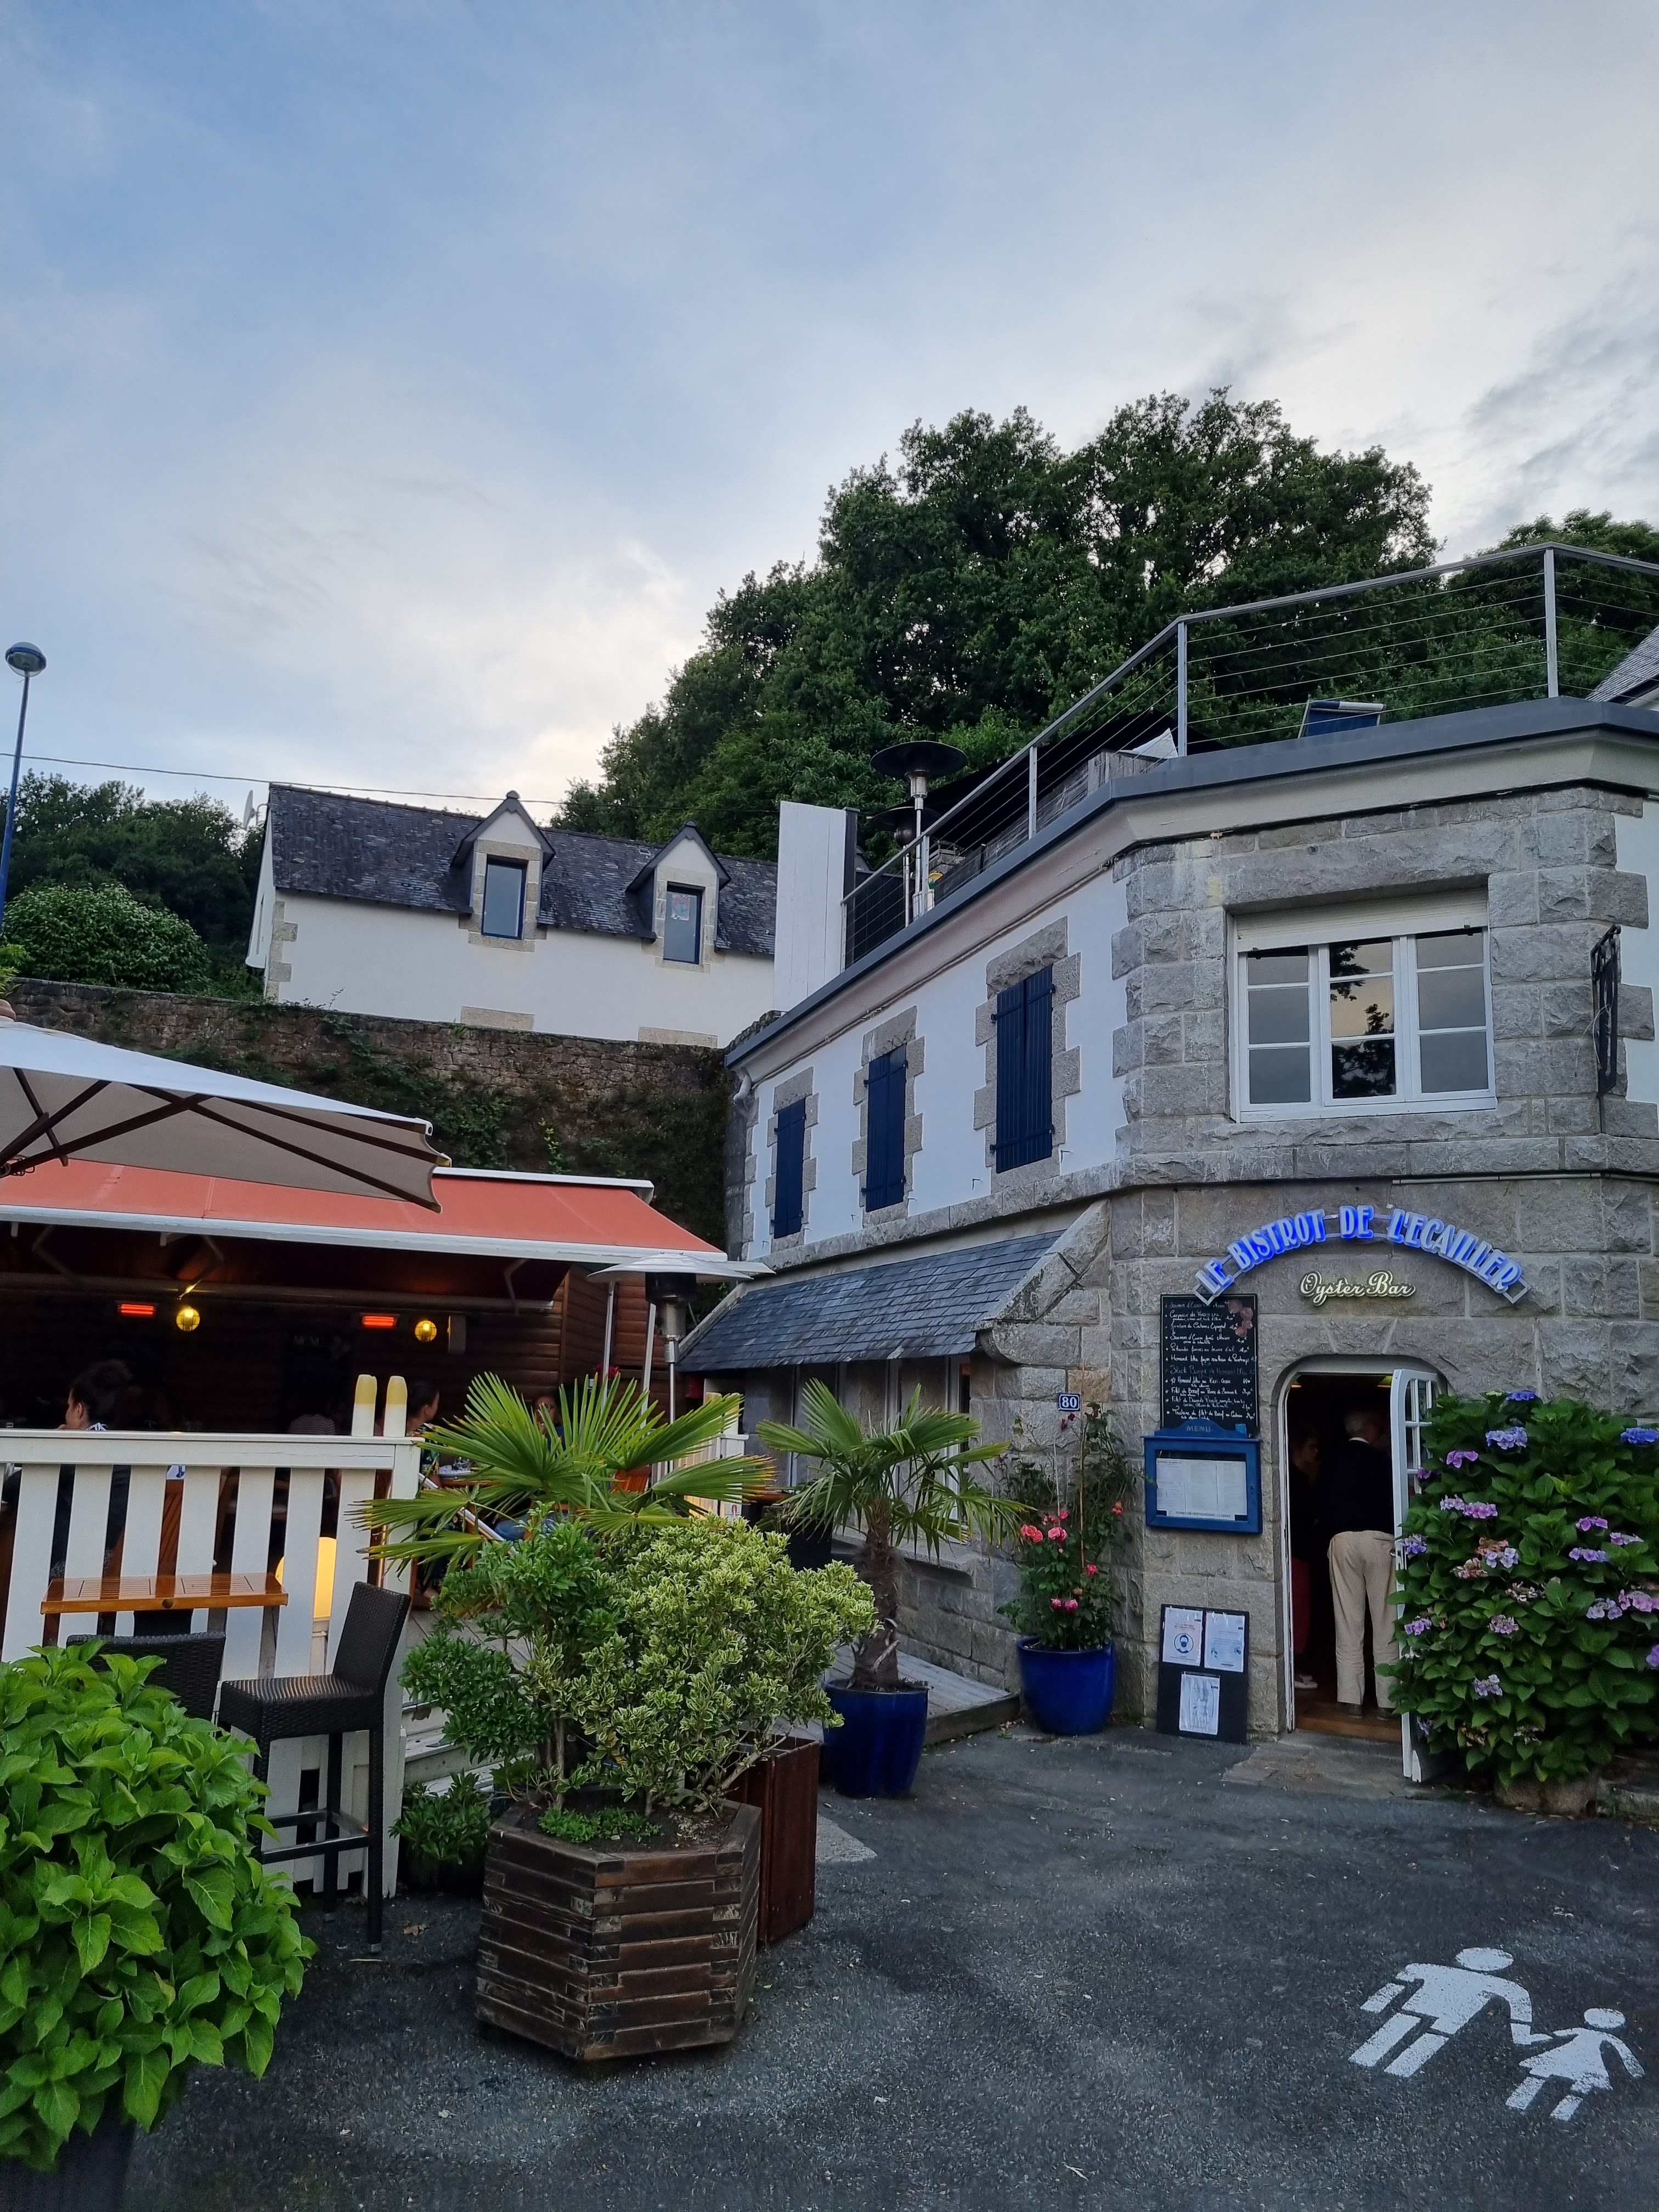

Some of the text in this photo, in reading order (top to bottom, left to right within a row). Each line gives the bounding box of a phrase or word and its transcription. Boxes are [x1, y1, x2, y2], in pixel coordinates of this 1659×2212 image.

[1195, 1205, 1521, 1296] LE BISTROT DE L'ECAILLER
[1300, 1270, 1415, 1306] Oyster Bar
[1062, 1396, 1077, 1408] 80
